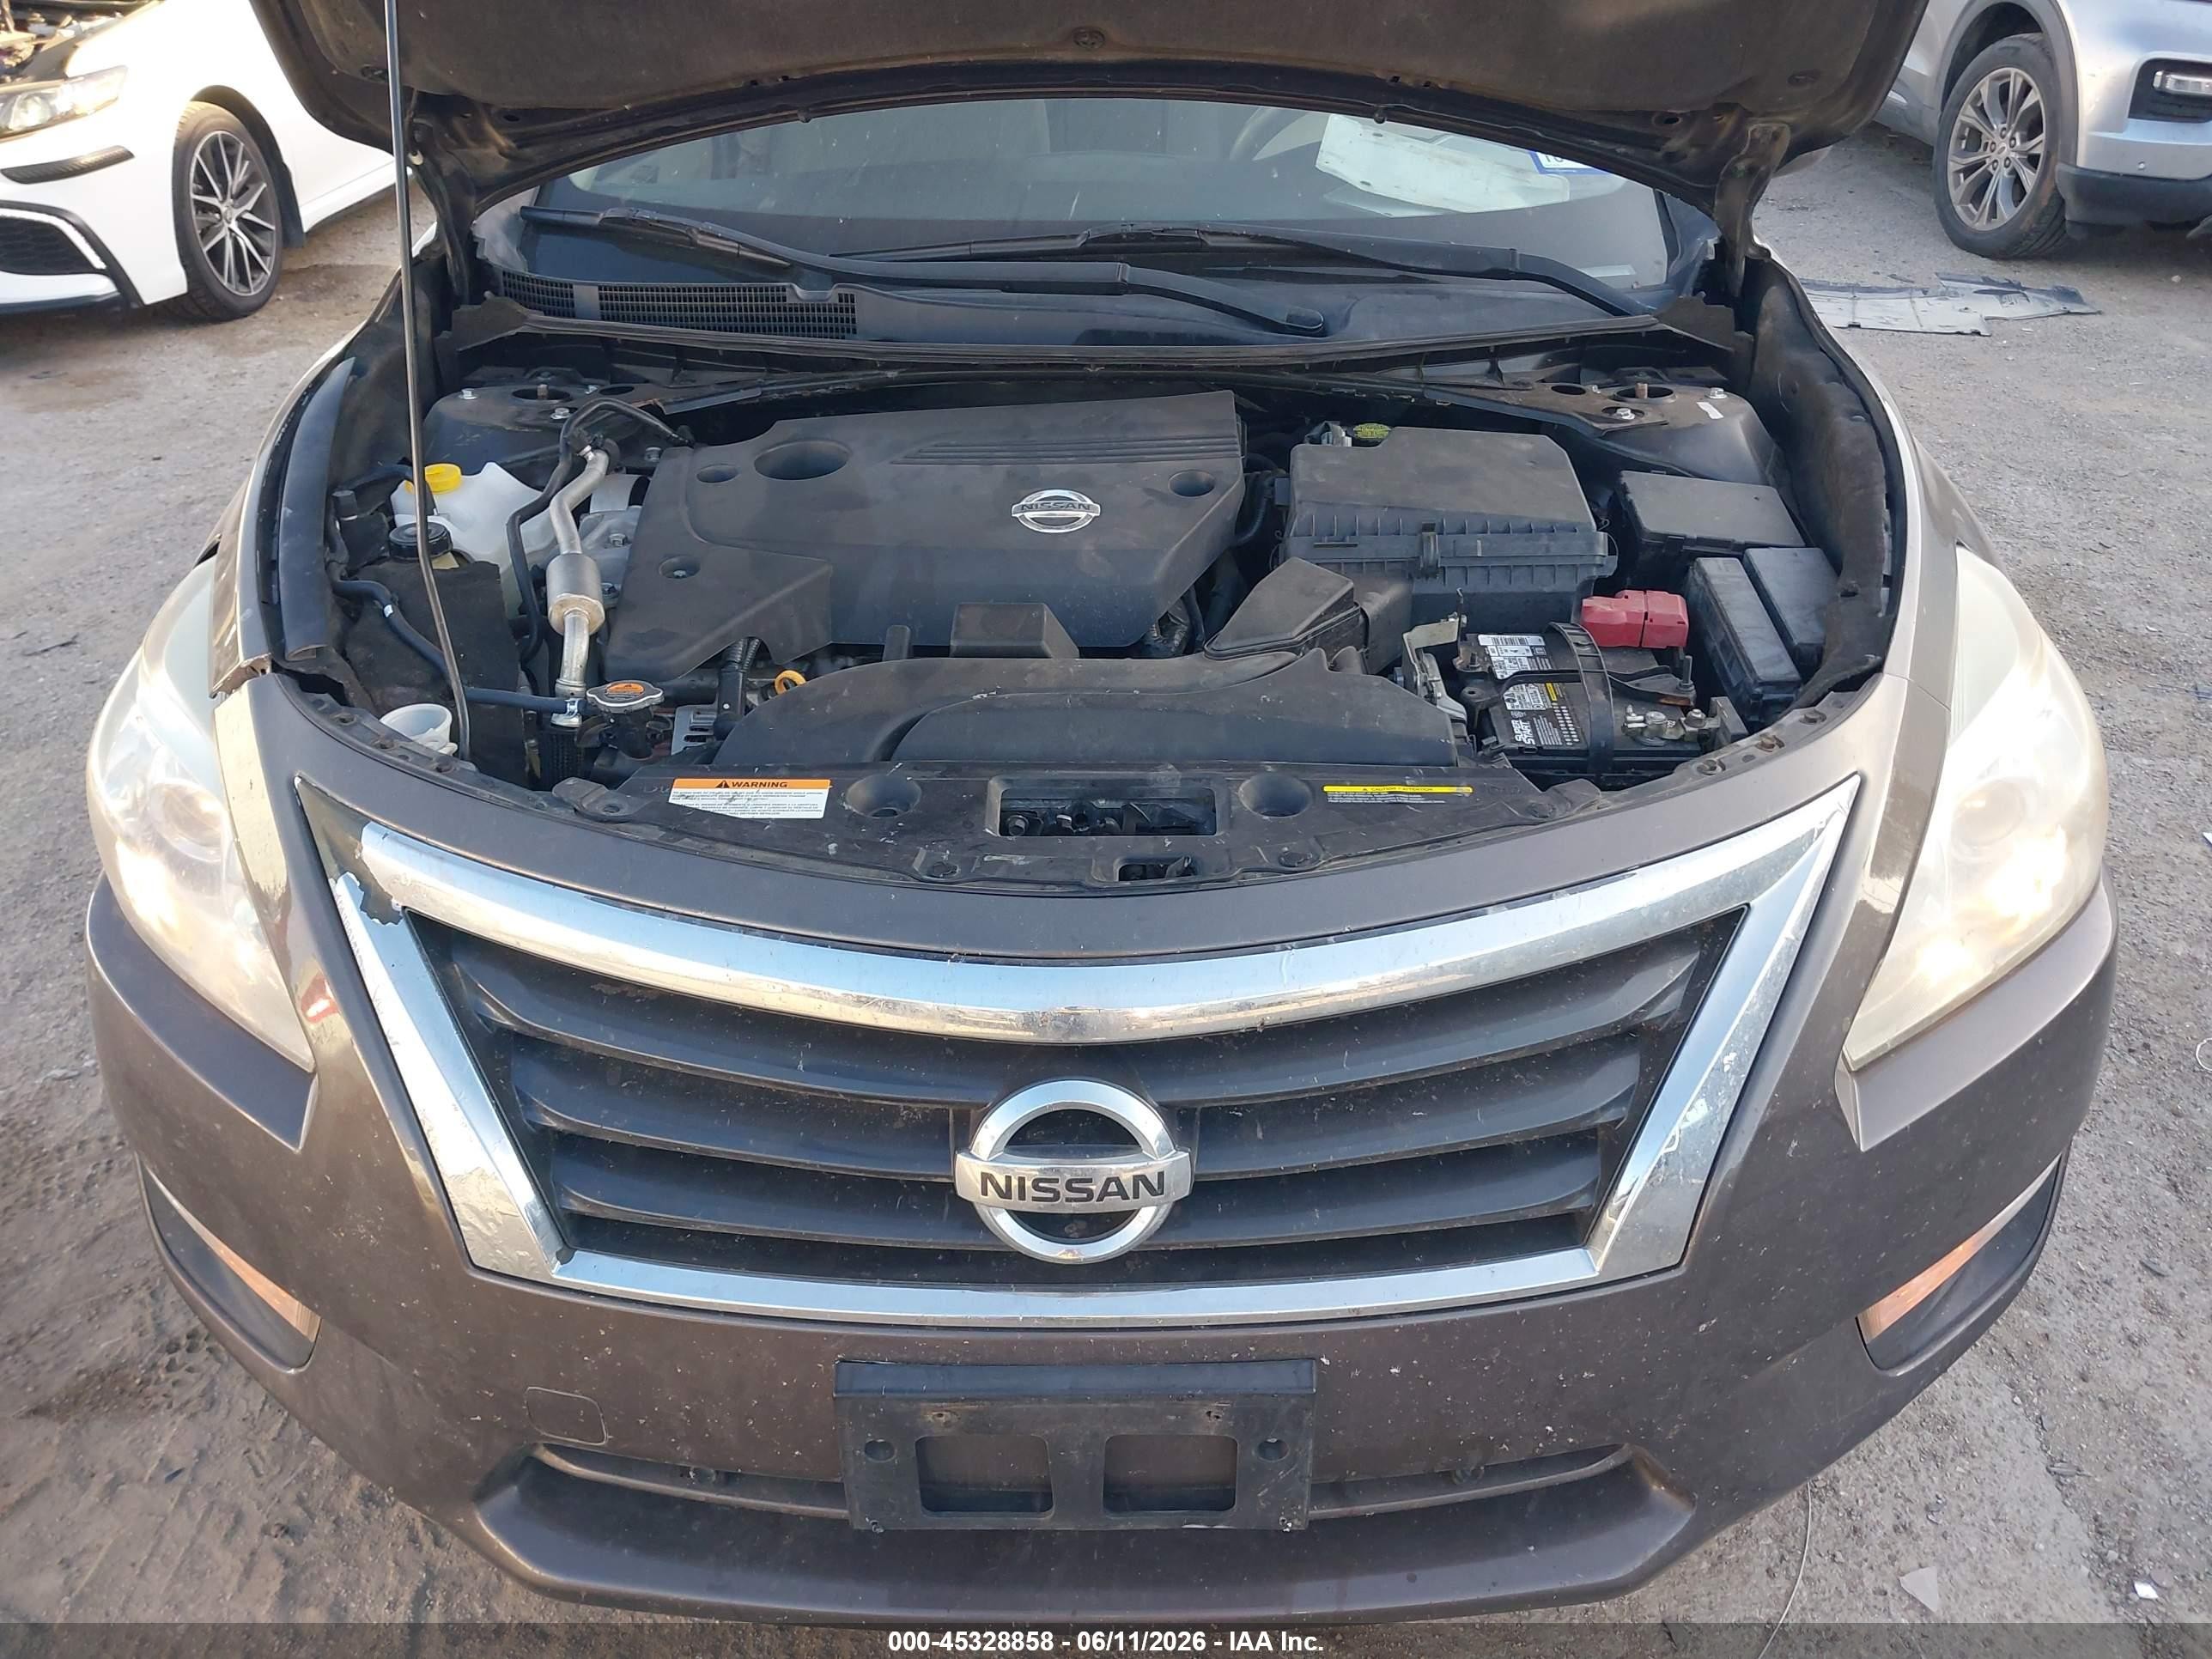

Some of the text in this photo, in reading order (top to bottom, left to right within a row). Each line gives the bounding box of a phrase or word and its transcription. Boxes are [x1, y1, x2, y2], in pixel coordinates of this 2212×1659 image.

[1021, 501, 1091, 511] NISSAN
[1511, 720, 1523, 742] SUPER
[1519, 720, 1536, 745] START
[980, 1170, 1164, 1203] NISSAN
